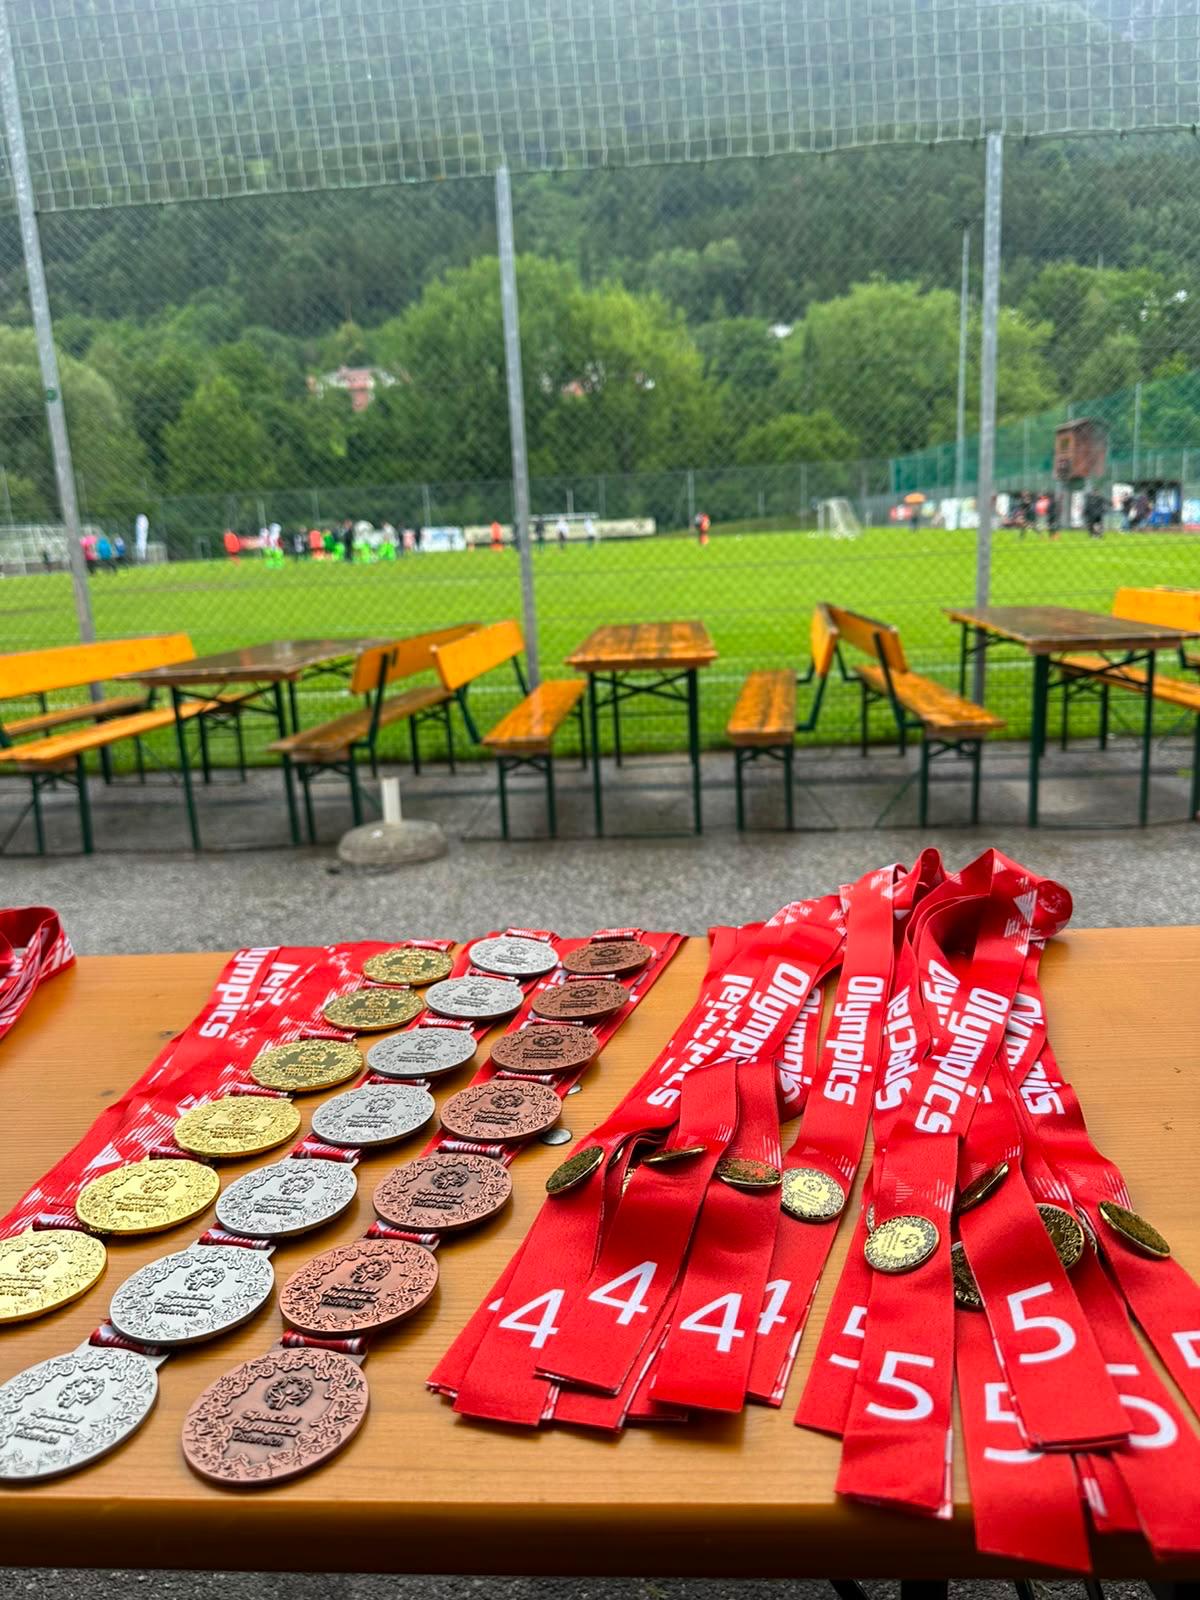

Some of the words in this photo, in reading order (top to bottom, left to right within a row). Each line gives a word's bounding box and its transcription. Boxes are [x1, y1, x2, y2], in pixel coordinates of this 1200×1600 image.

[823, 975, 885, 1106] Olympics
[875, 985, 919, 1110] Special
[914, 987, 1010, 1134] Olympics
[498, 1288, 566, 1349] 4
[587, 1261, 658, 1325] 4
[680, 1292, 745, 1353] 4
[1006, 1281, 1077, 1364] 5
[865, 1350, 935, 1421] 5
